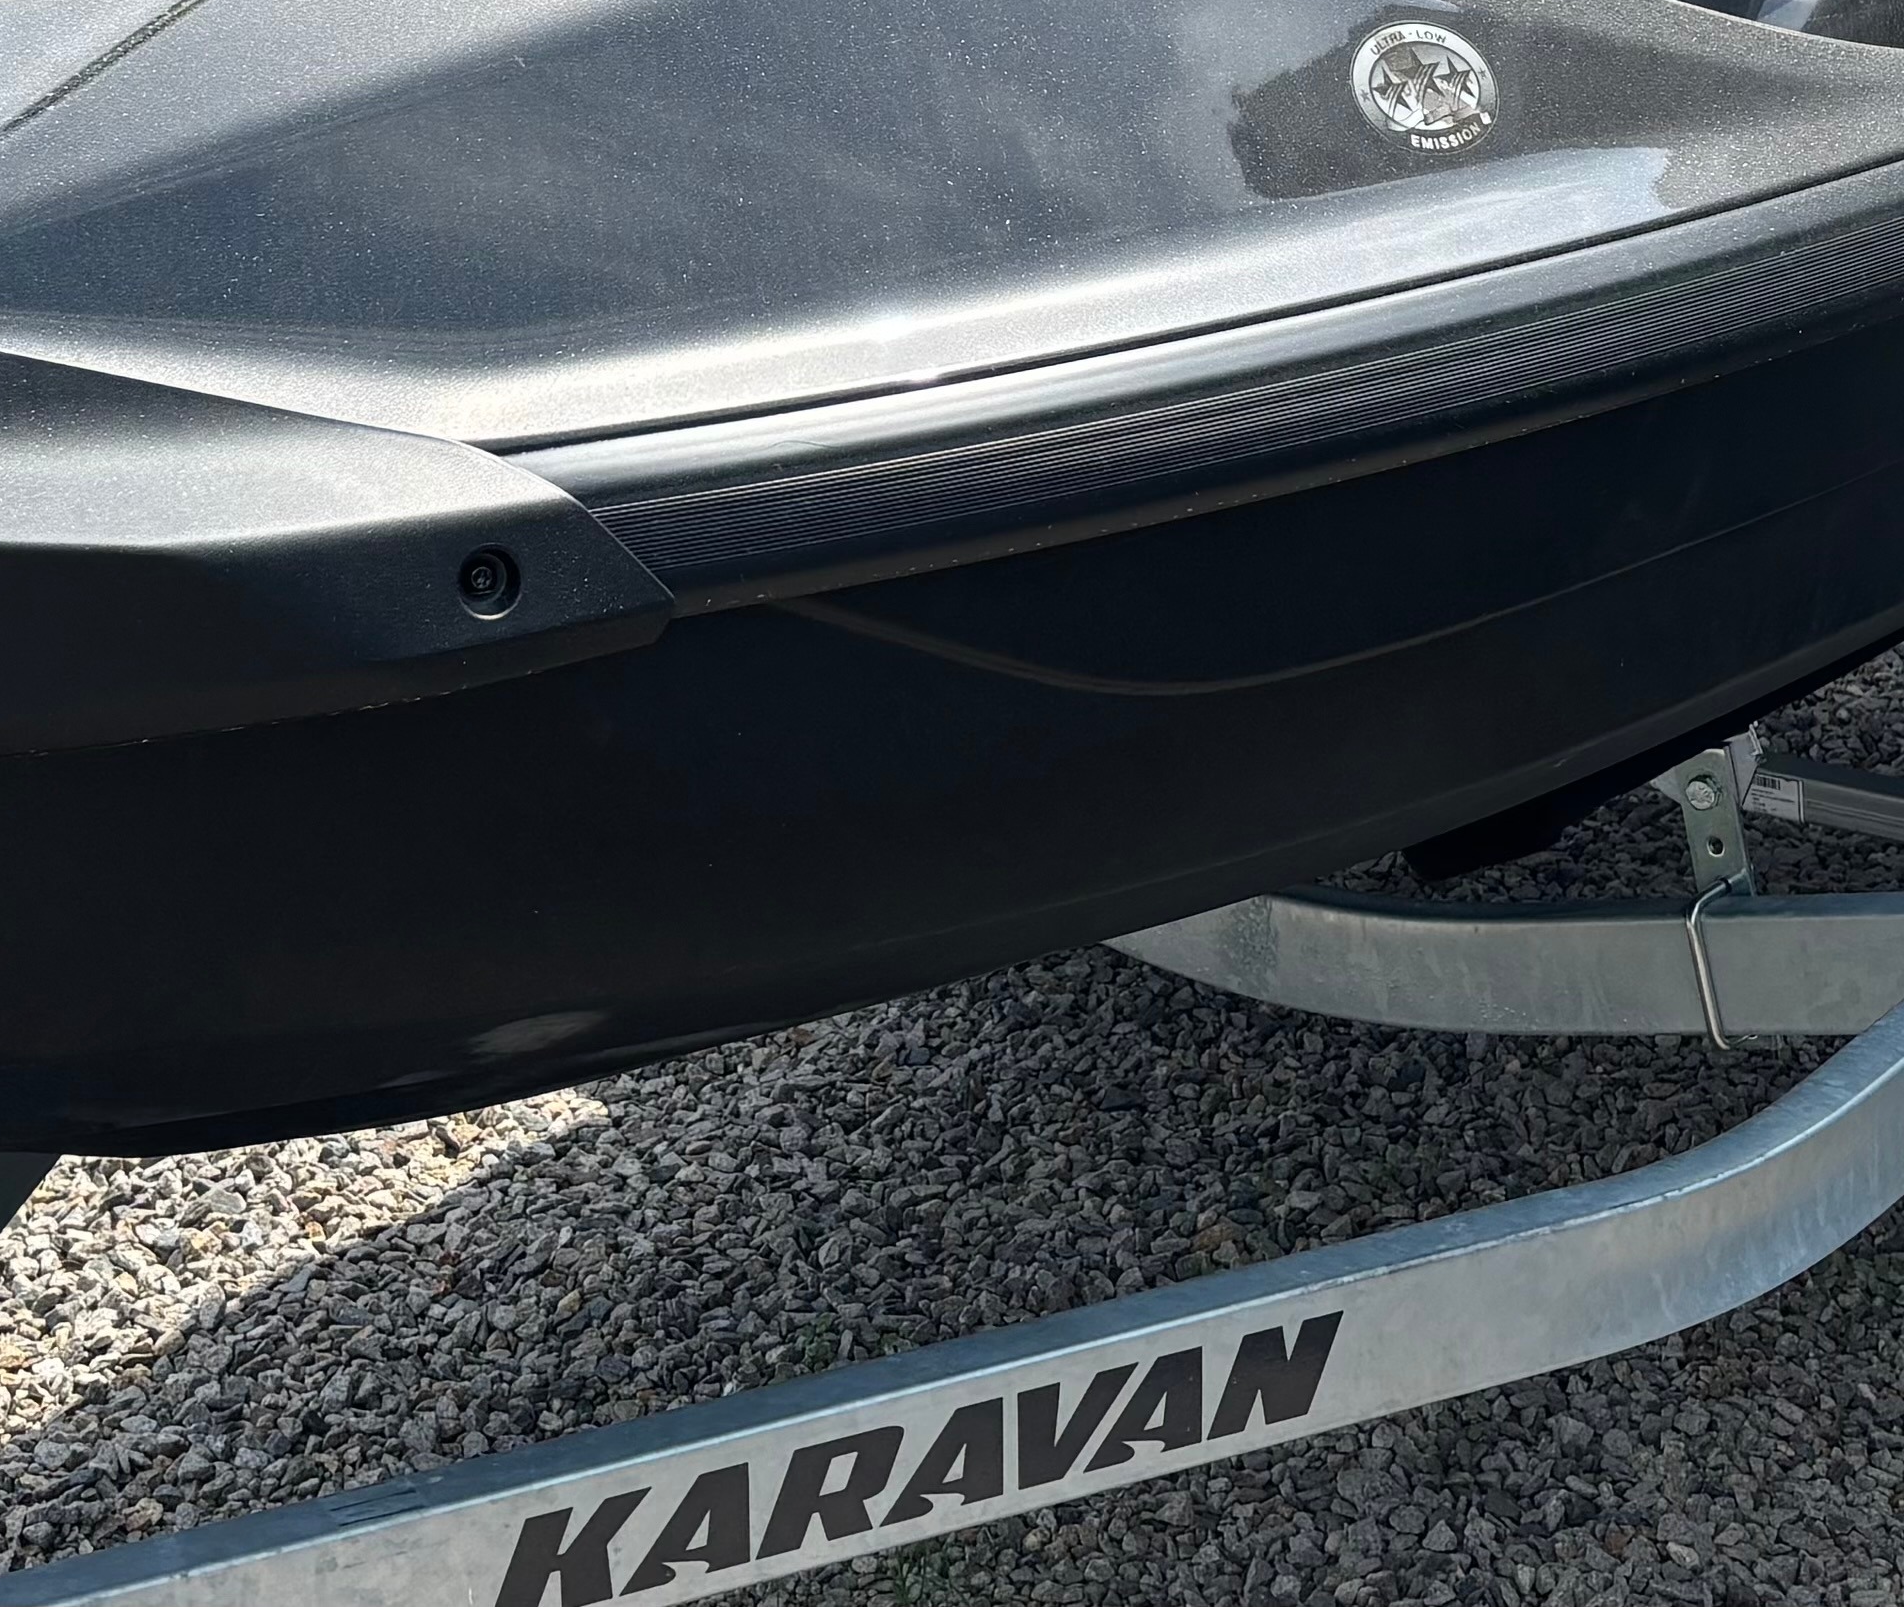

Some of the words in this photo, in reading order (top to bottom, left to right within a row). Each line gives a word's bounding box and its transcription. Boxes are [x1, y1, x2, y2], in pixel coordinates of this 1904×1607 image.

[1370, 29, 1406, 56] ULTRA
[1410, 123, 1481, 150] EMISSION
[494, 1311, 1344, 1607] KARAVAN
